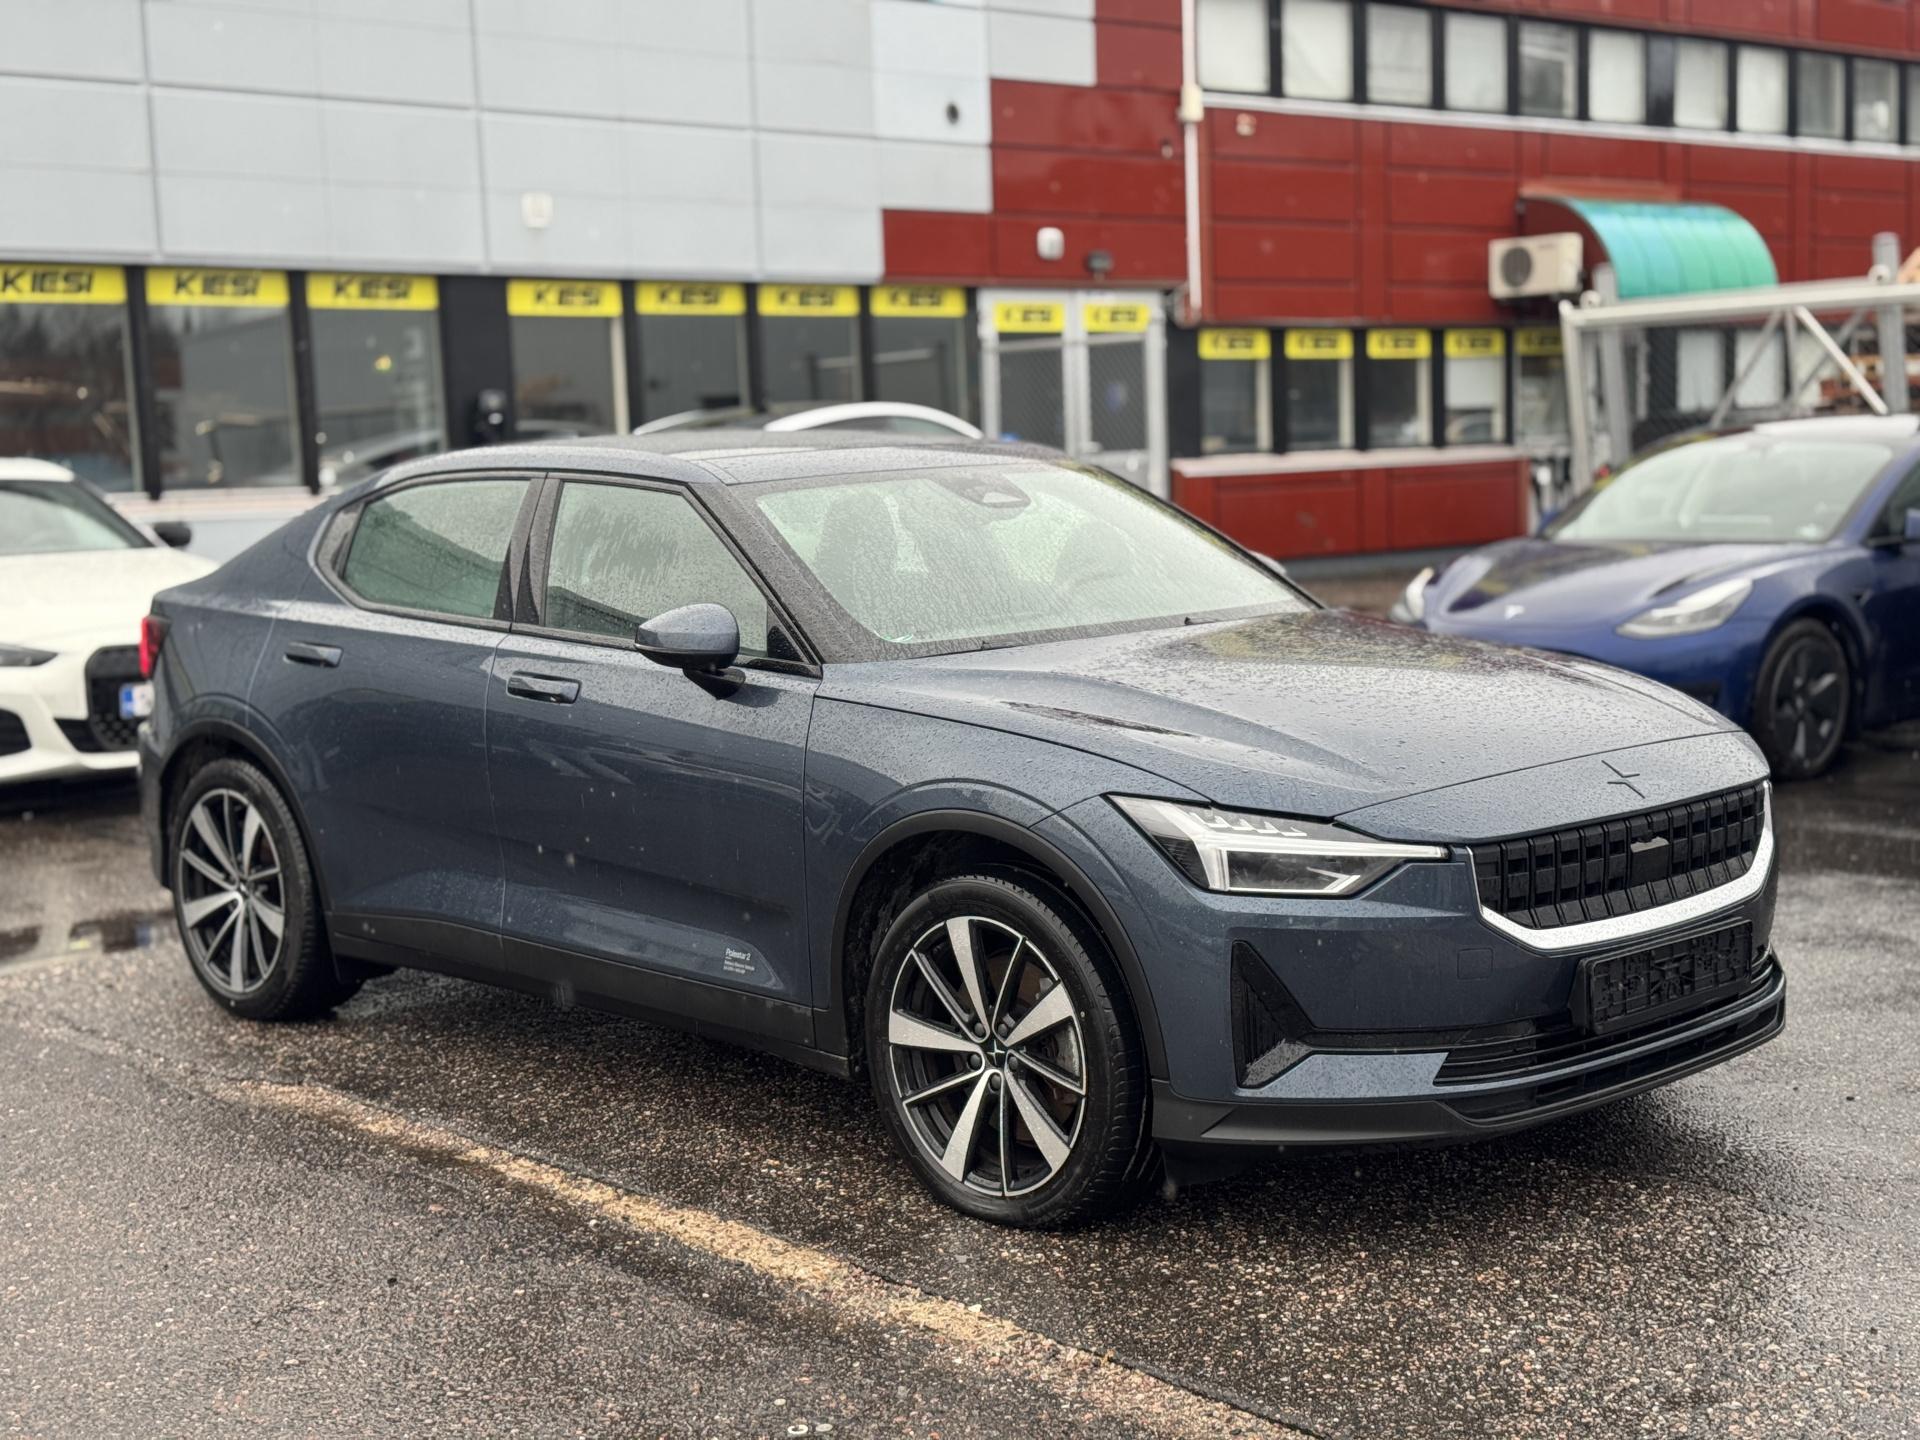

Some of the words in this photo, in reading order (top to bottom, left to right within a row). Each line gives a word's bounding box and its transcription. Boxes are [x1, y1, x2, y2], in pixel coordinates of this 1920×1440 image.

[2, 269, 94, 293] KIESI
[174, 271, 261, 295] KIESI
[334, 275, 413, 299] KIESI
